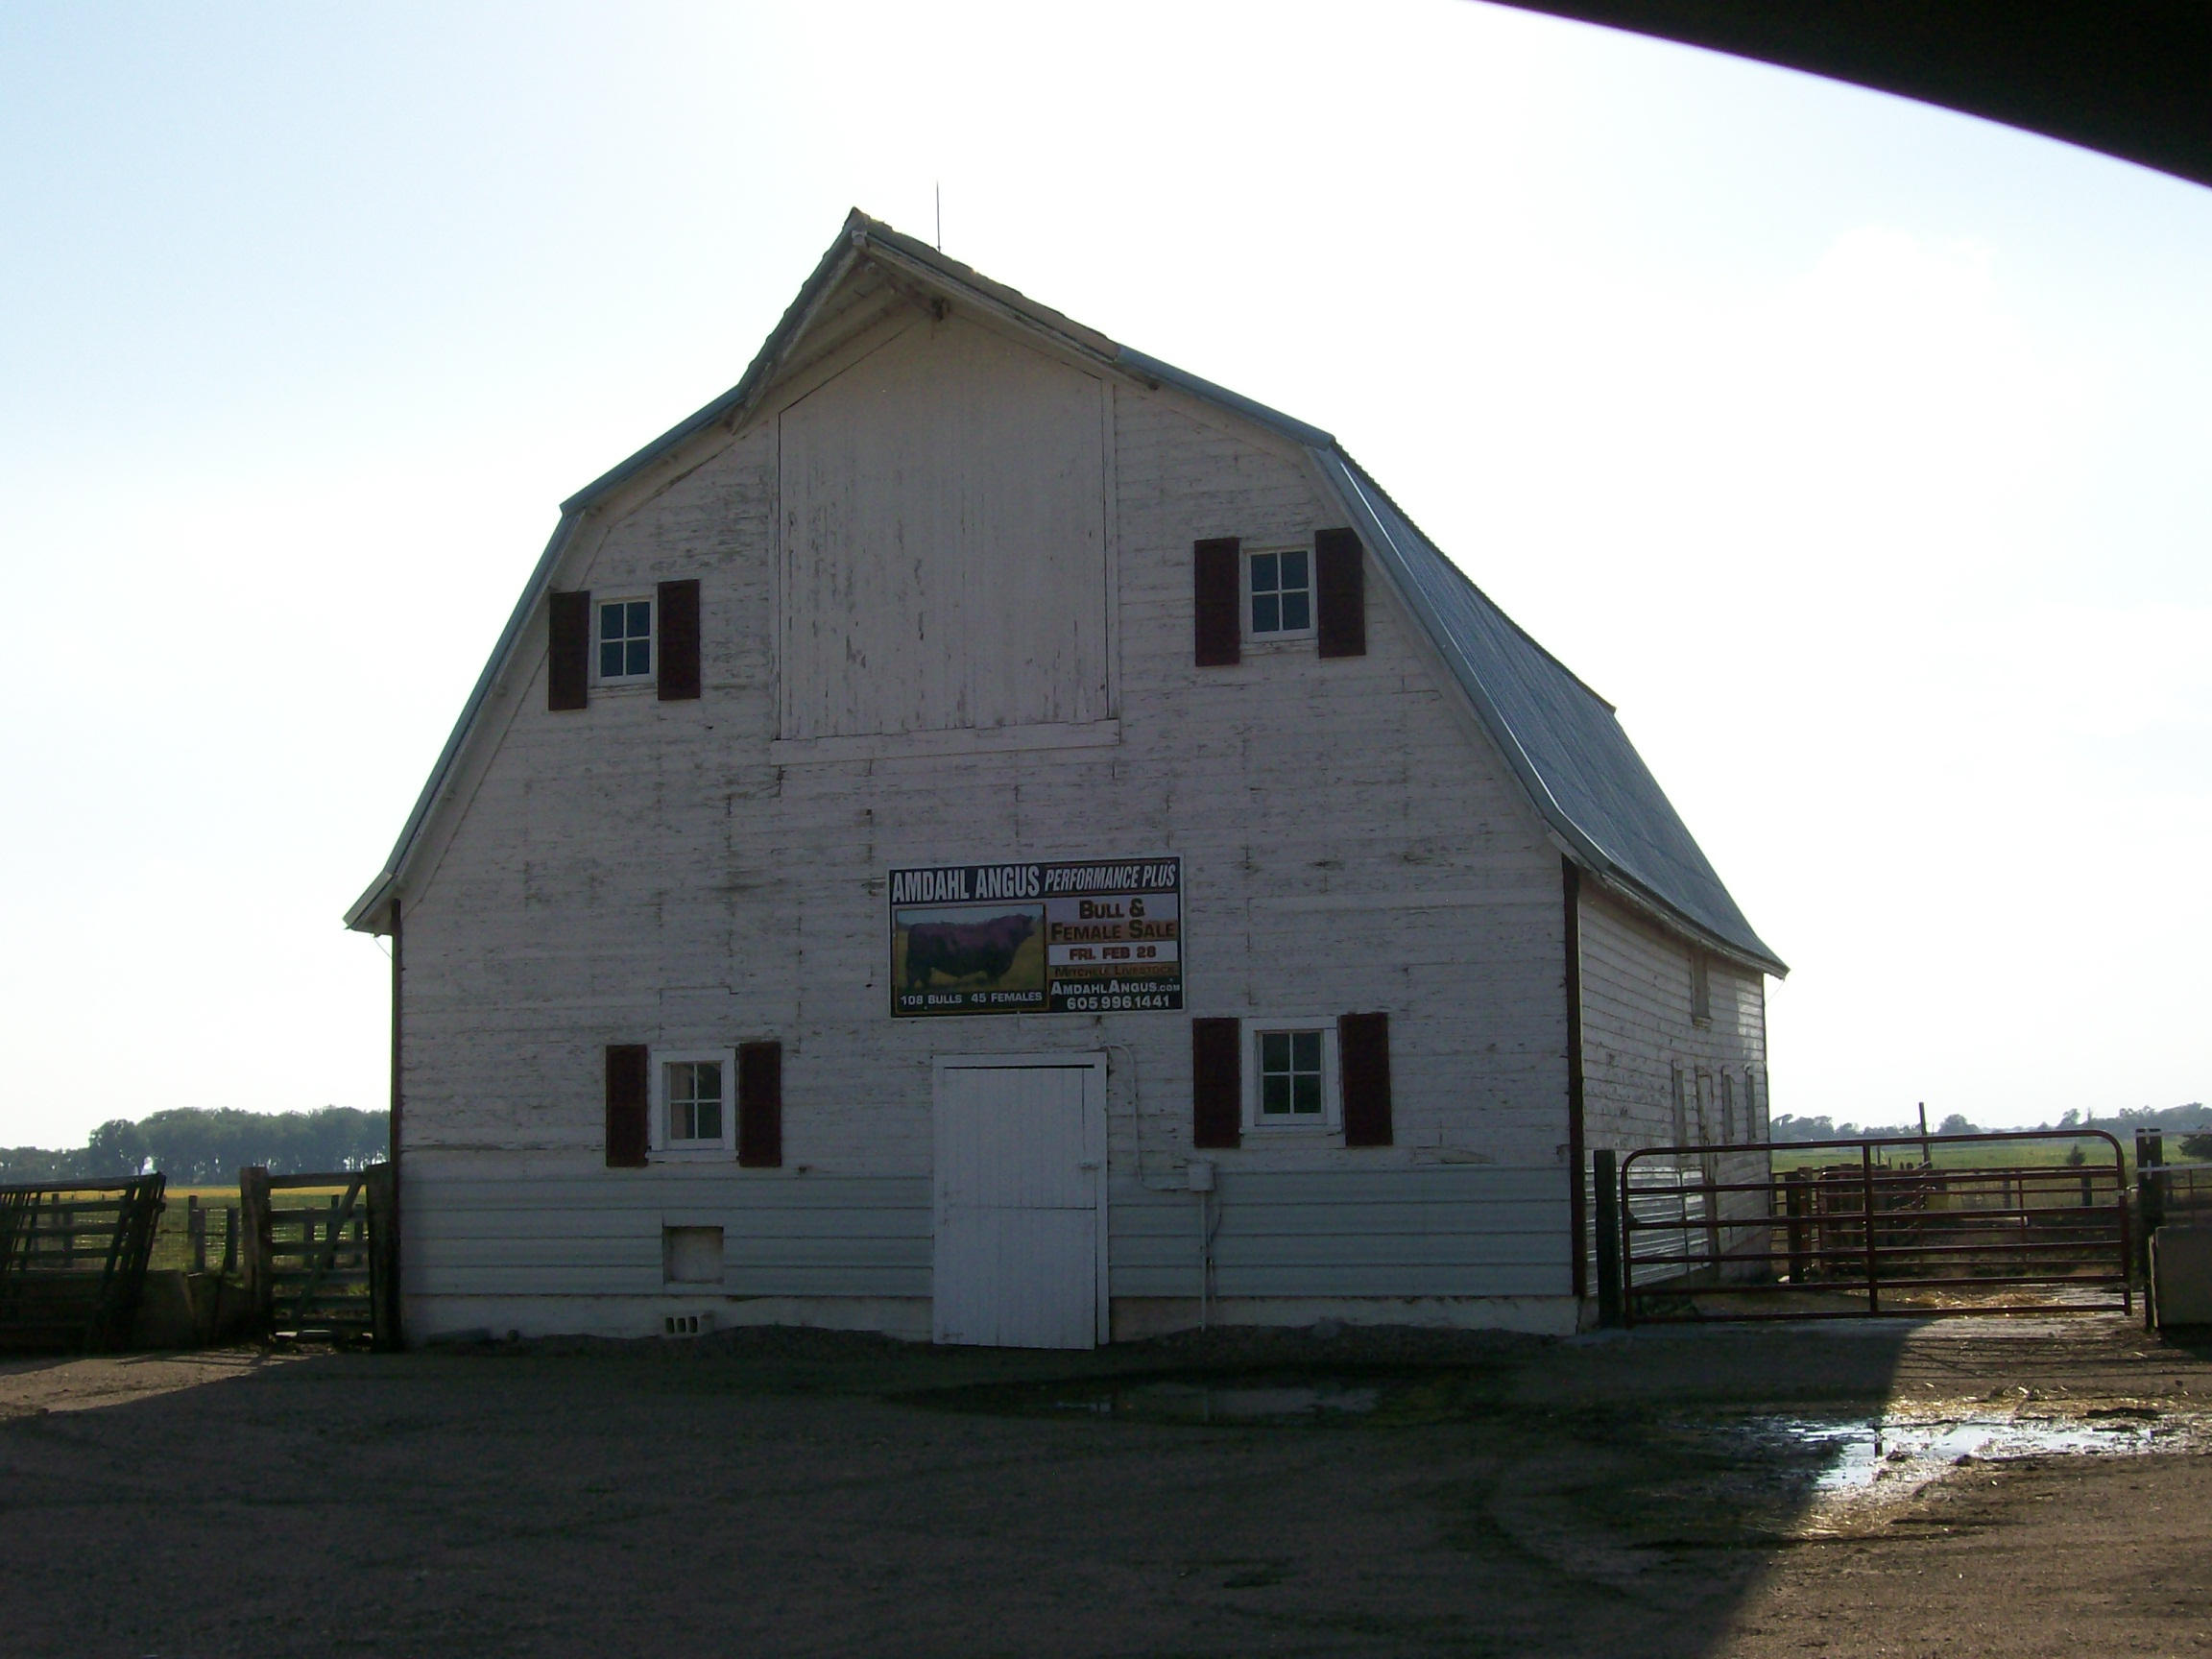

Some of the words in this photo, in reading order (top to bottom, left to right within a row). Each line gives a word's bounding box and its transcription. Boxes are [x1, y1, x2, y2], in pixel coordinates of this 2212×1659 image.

[892, 869, 970, 902] AMDAHL
[975, 866, 1040, 899] ANGUS
[1045, 865, 1140, 892] PERFORMANCE
[1142, 863, 1176, 888] PLUS
[1079, 900, 1124, 919] BULL
[1129, 898, 1145, 918] &
[1051, 922, 1122, 941] FEMALE
[1129, 919, 1176, 938] SALE
[1102, 947, 1130, 959] FEB
[1137, 946, 1157, 958] 28
[927, 993, 963, 1004] BULLS
[971, 993, 987, 1002] 45
[991, 992, 1043, 1002] FEMALES
